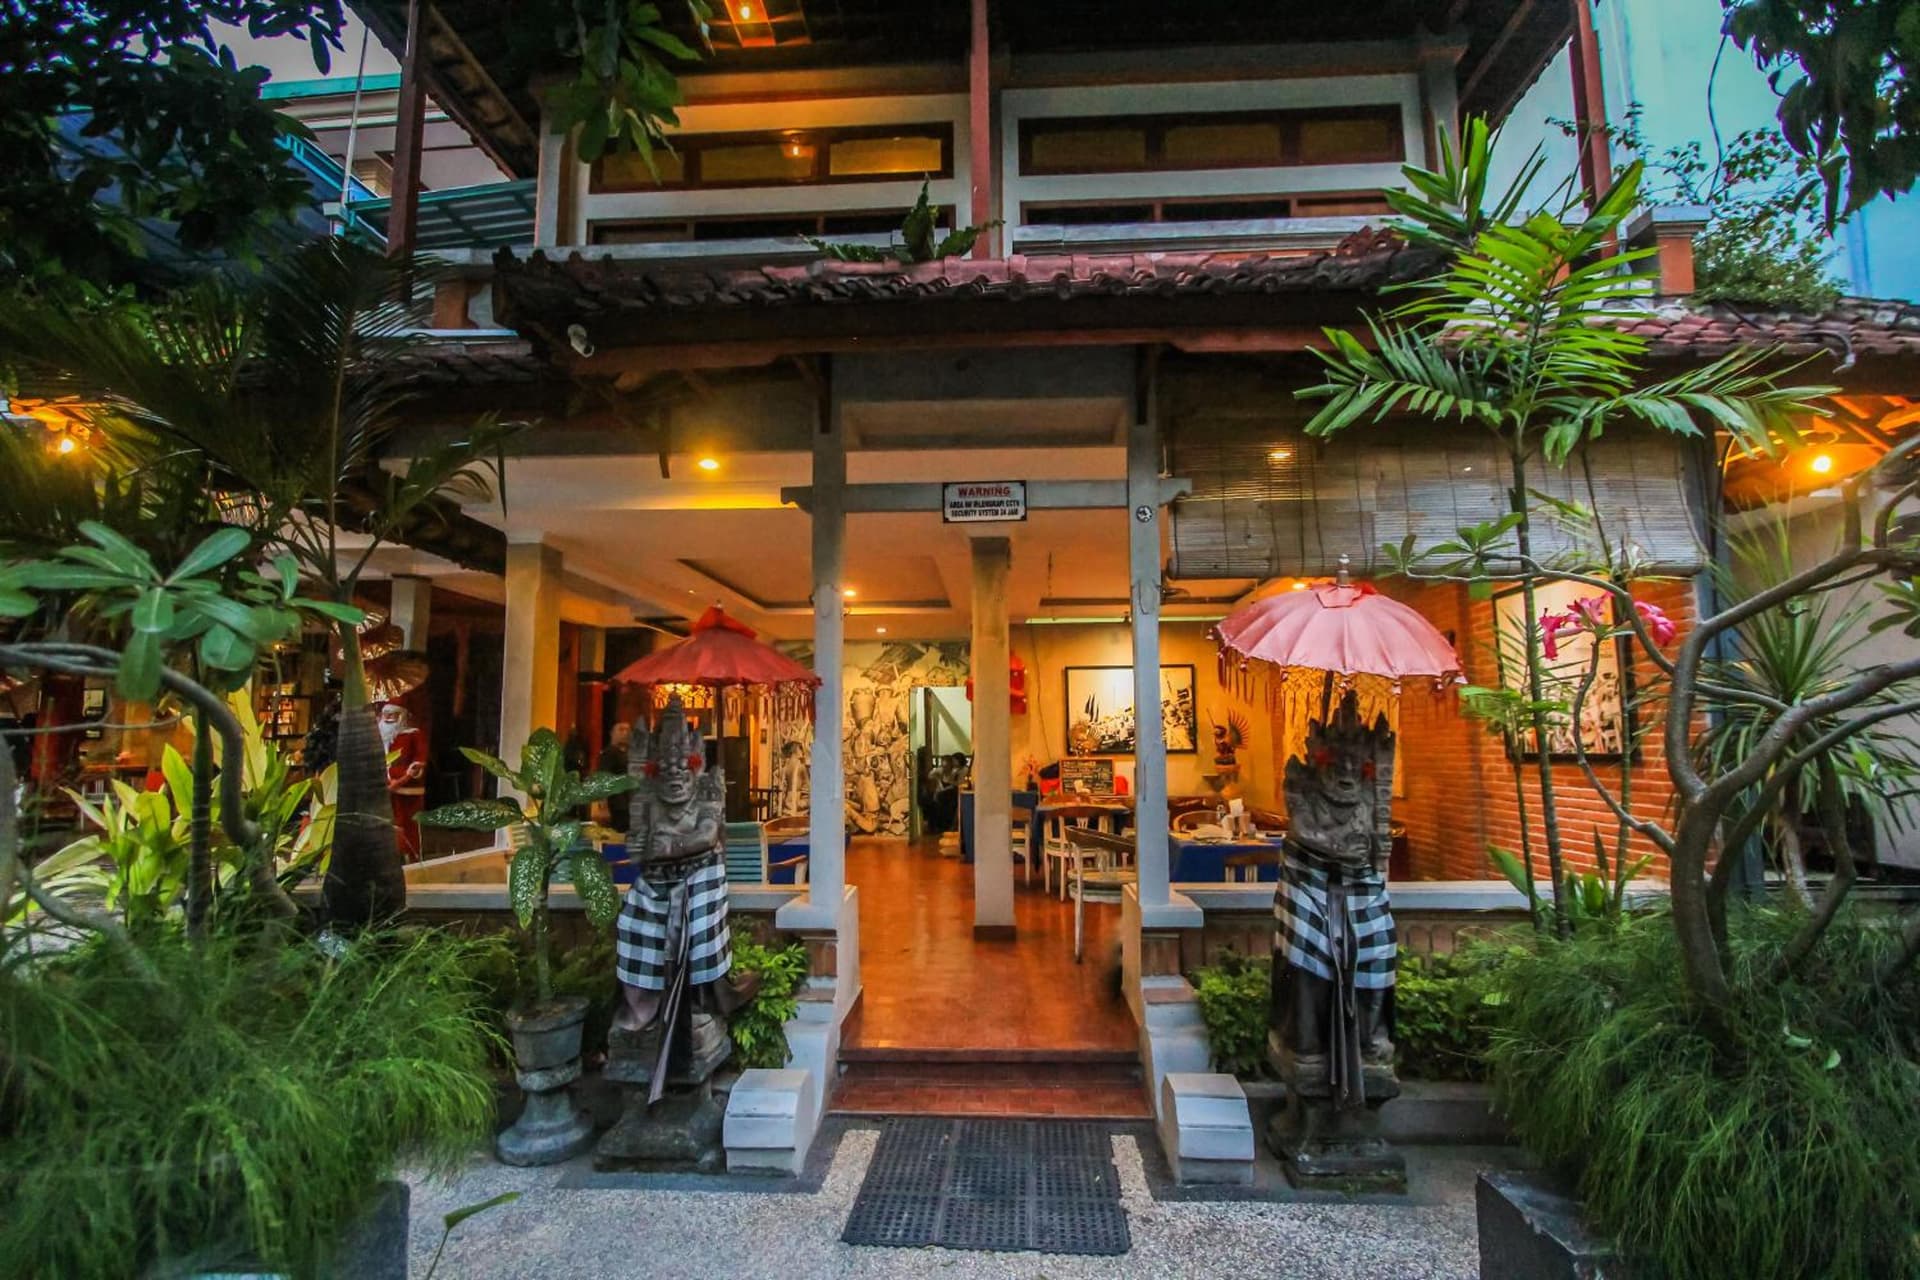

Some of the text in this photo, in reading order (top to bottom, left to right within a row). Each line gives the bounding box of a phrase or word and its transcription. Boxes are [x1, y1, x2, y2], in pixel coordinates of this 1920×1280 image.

[958, 487, 1011, 497] WARNING
[951, 509, 977, 517] SECURITY
[979, 508, 999, 517] SYSTEM
